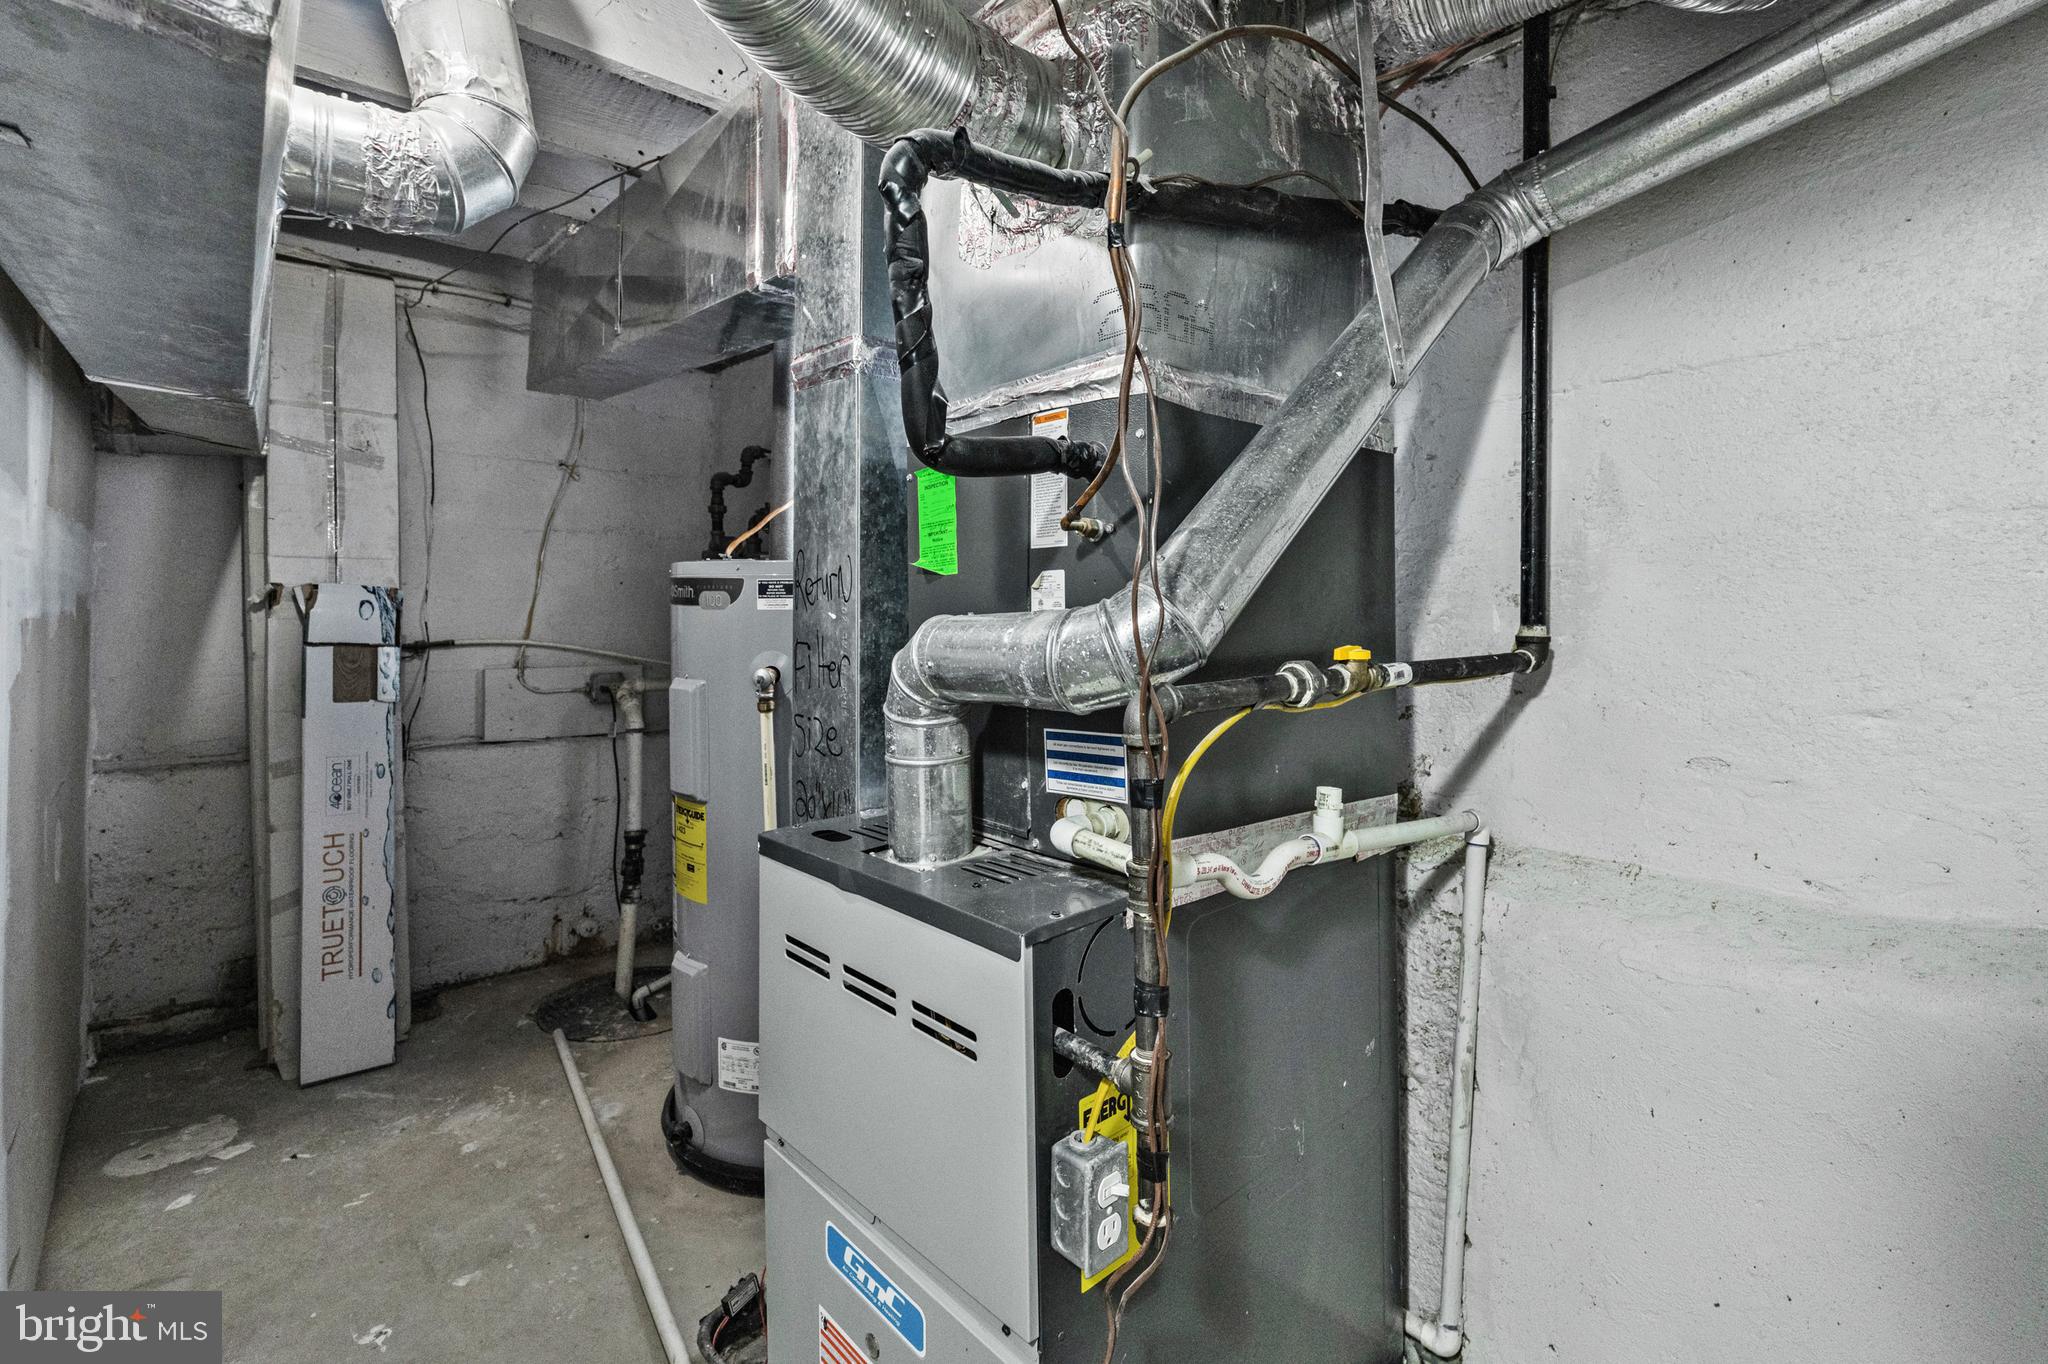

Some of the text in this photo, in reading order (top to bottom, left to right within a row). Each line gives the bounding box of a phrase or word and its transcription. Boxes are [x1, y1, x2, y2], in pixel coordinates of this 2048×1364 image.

[794, 629, 851, 695] Filter
[794, 713, 844, 758] Size
[321, 832, 348, 982] TRUETOUCH
[848, 1271, 877, 1303] Conditioning
[881, 1305, 901, 1327] Heating
